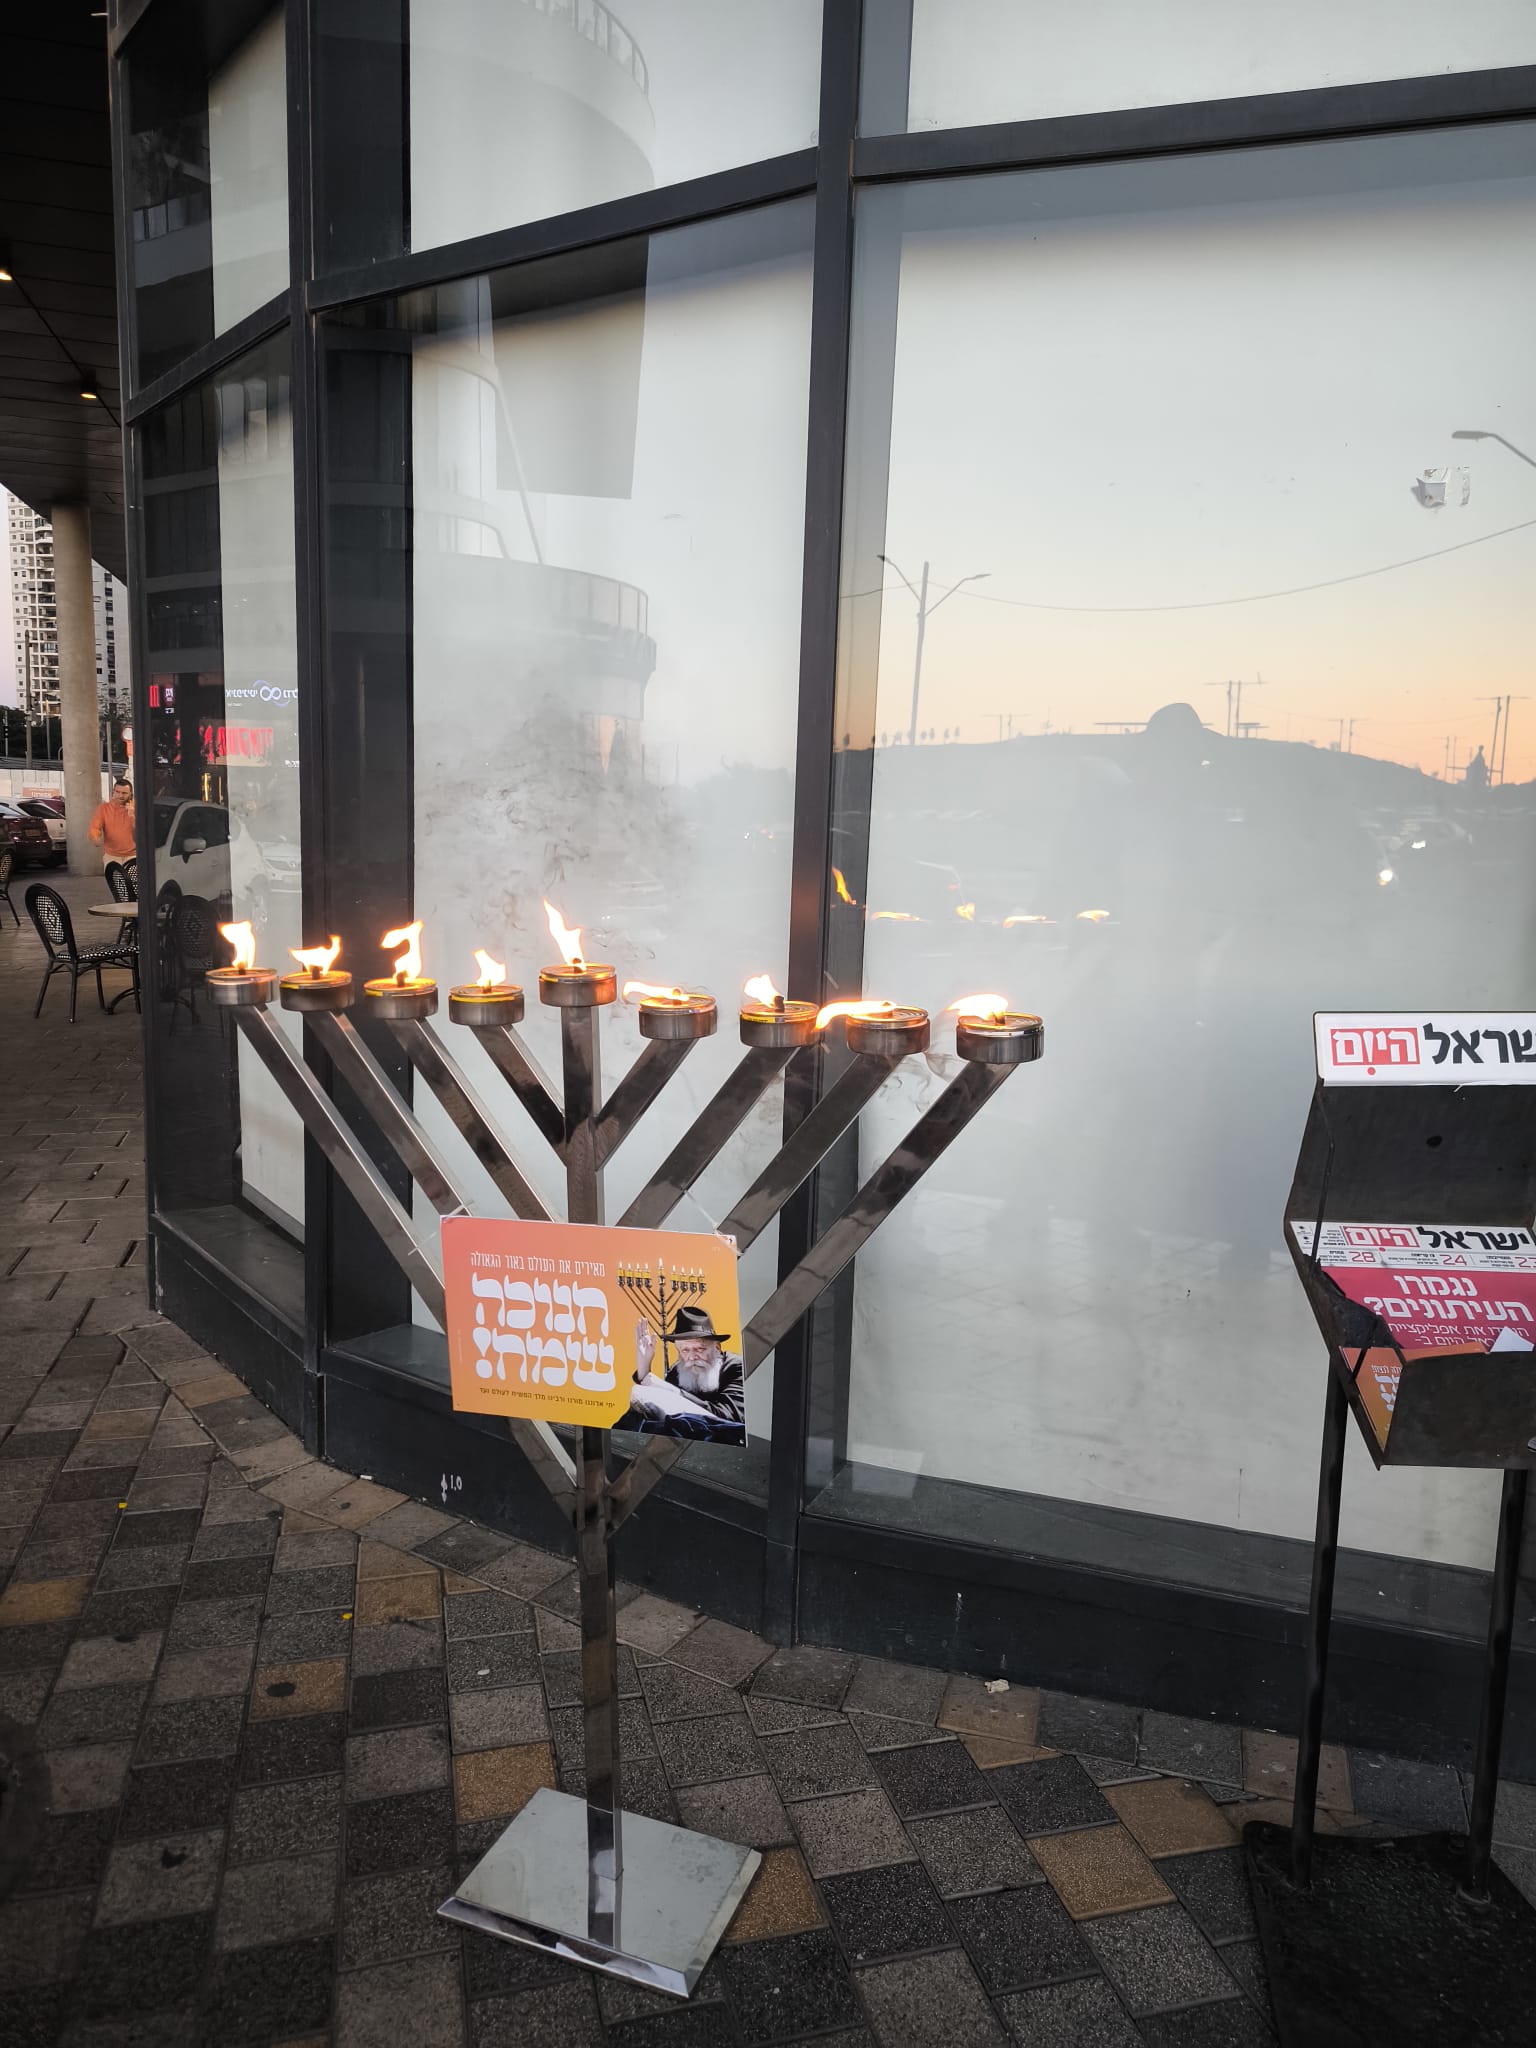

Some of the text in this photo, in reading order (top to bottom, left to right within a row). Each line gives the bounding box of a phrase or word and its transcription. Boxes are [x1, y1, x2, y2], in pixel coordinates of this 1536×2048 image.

[1333, 1029, 1418, 1075] היום
[1345, 1227, 1418, 1252] היום
[1416, 1226, 1531, 1251] ישראל
[470, 1250, 606, 1277] מאירים את העולם באור הגאולה
[1348, 1251, 1376, 1263] 28
[1439, 1254, 1467, 1266] 24
[1393, 1275, 1478, 1297] נגמרו
[471, 1271, 609, 1338] חנוכה
[1363, 1296, 1535, 1322] העיתונים?
[1387, 1322, 1530, 1338] הודו את אפליקציית
[472, 1327, 616, 1393] שמח!
[479, 1386, 490, 1394] ועד
[491, 1388, 510, 1397] לעולם
[511, 1391, 532, 1399] המשיח
[534, 1393, 546, 1401] מלך
